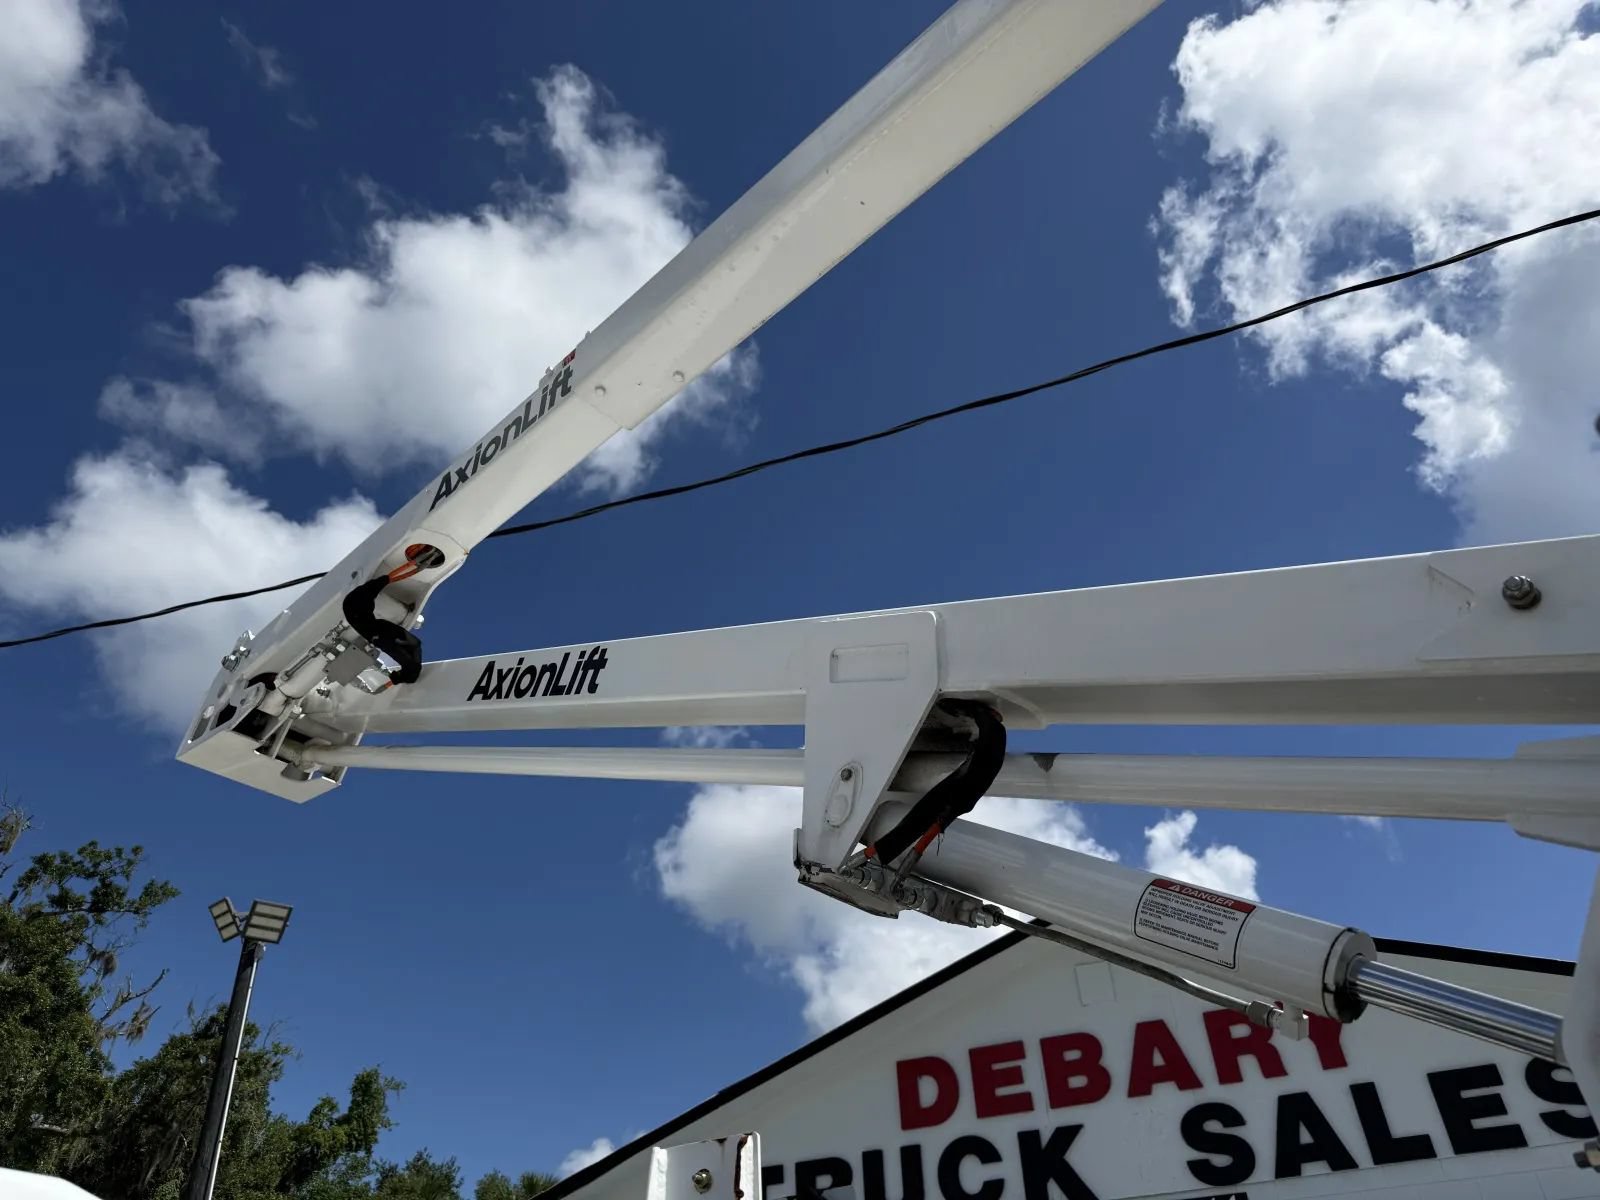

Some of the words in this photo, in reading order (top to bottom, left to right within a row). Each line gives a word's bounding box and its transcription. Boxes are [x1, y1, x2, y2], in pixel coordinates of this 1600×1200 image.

[428, 364, 574, 513] AxionLift
[466, 645, 608, 702] AxionLift
[1182, 888, 1234, 907] DANGER
[761, 1123, 1101, 1200] UCK
[1179, 1057, 1600, 1187] SALES
[896, 1001, 1348, 1131] DEBARY
